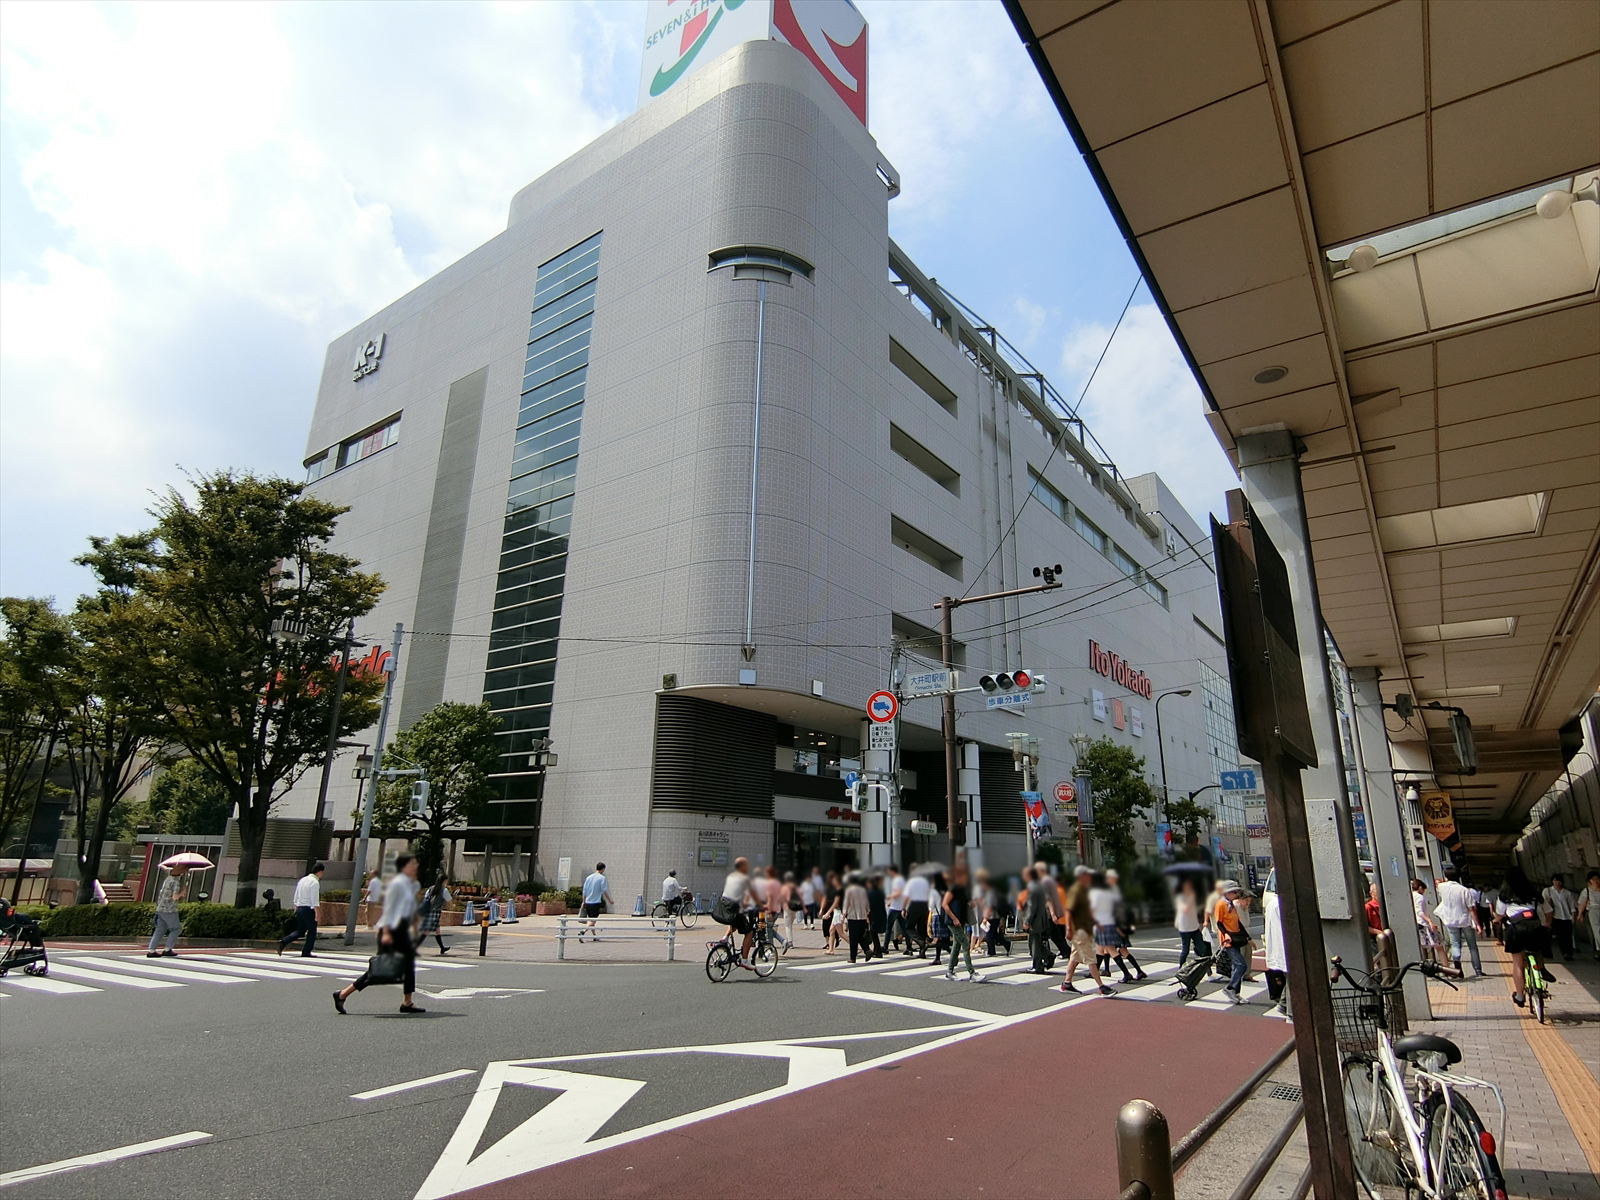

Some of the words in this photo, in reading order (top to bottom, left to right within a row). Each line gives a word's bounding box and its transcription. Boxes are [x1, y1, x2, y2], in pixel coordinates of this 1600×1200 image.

[1089, 639, 1110, 677] Ito
[1108, 650, 1153, 700] Yokado
[910, 672, 947, 686] 大井町駅前
[988, 693, 1030, 707] 歩車分離式
